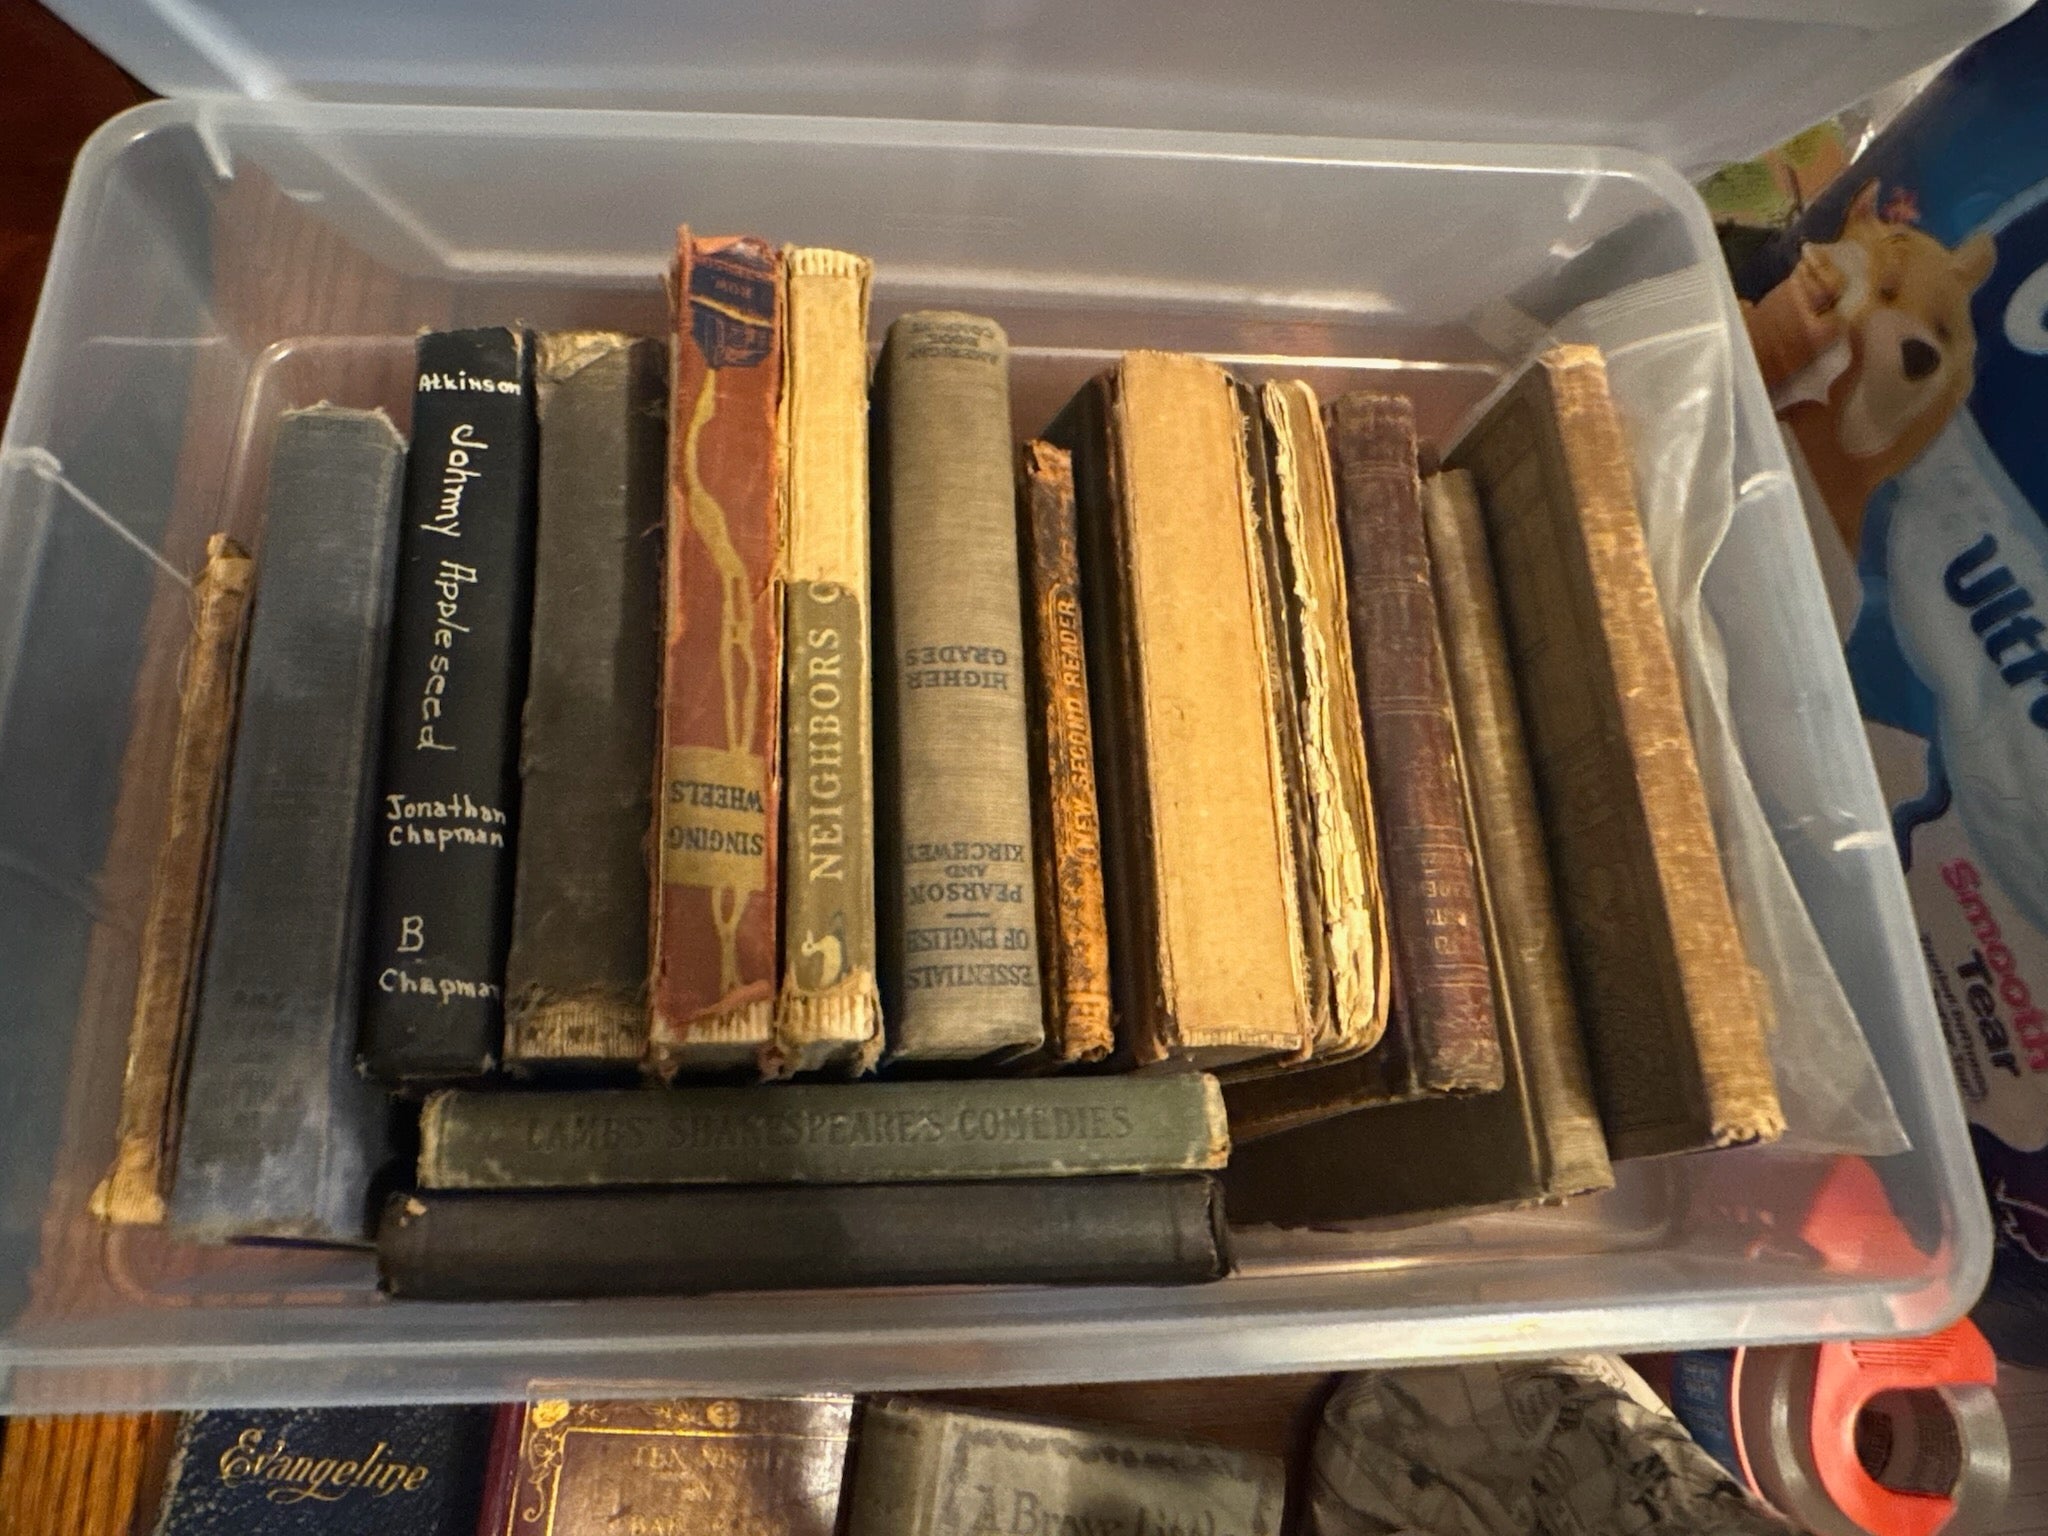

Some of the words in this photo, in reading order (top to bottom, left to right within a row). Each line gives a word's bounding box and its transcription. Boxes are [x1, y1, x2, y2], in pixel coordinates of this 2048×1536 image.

[418, 370, 522, 396] Atkinson
[419, 423, 489, 538] Johnny
[1057, 594, 1083, 689] READER
[1943, 531, 2048, 729] Ultr
[414, 559, 479, 751] Appleseed
[905, 645, 1007, 667] GRADES
[905, 670, 1007, 691] HIGHER
[808, 627, 844, 882] NEIGHBORS
[1066, 697, 1090, 787] SECOND
[385, 794, 507, 825] Jonathan
[670, 781, 765, 815] WHEELS
[388, 824, 505, 853] Chapman
[668, 826, 764, 857] SINGING
[1073, 798, 1097, 851] NEW
[903, 841, 1025, 863] KIRCHWE
[944, 864, 988, 879] AND
[908, 881, 1023, 906] PEARSON
[397, 914, 425, 952] B
[1003, 926, 1028, 951] OF
[907, 963, 1034, 990] ESSENTIALS
[1957, 948, 2020, 1078] Tear
[958, 1105, 1134, 1142] COMEDIES
[218, 1428, 429, 1504] Evangeline
